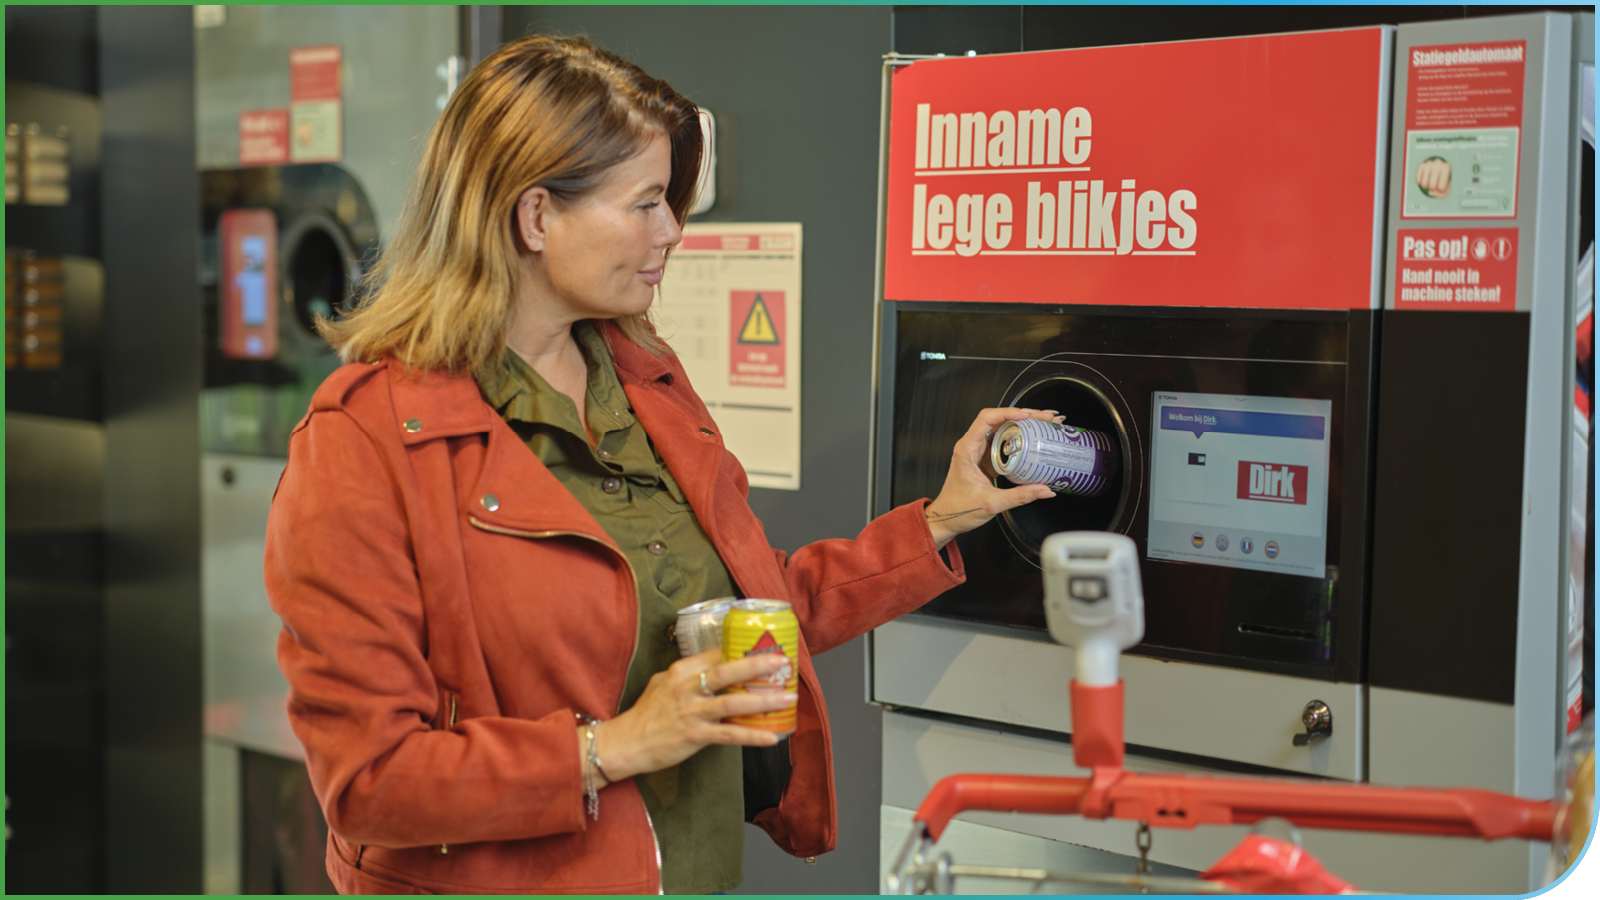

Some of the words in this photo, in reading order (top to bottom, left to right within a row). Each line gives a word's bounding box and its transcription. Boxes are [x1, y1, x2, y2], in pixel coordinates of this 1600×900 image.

[1412, 45, 1524, 66] Statiegeldautomaat
[914, 103, 1092, 169] Inname
[912, 183, 1013, 257] lege
[1025, 179, 1197, 255] blikjes
[1403, 236, 1436, 259] Pas
[1438, 235, 1468, 261] op!
[1402, 268, 1433, 284] Hand
[1434, 268, 1466, 284] nooit
[1467, 267, 1480, 284] in
[1401, 285, 1453, 302] machine
[1455, 284, 1501, 303] steken!
[1168, 413, 1194, 422] Welkom
[1194, 414, 1203, 424] bij
[1248, 463, 1295, 498] Dirk
